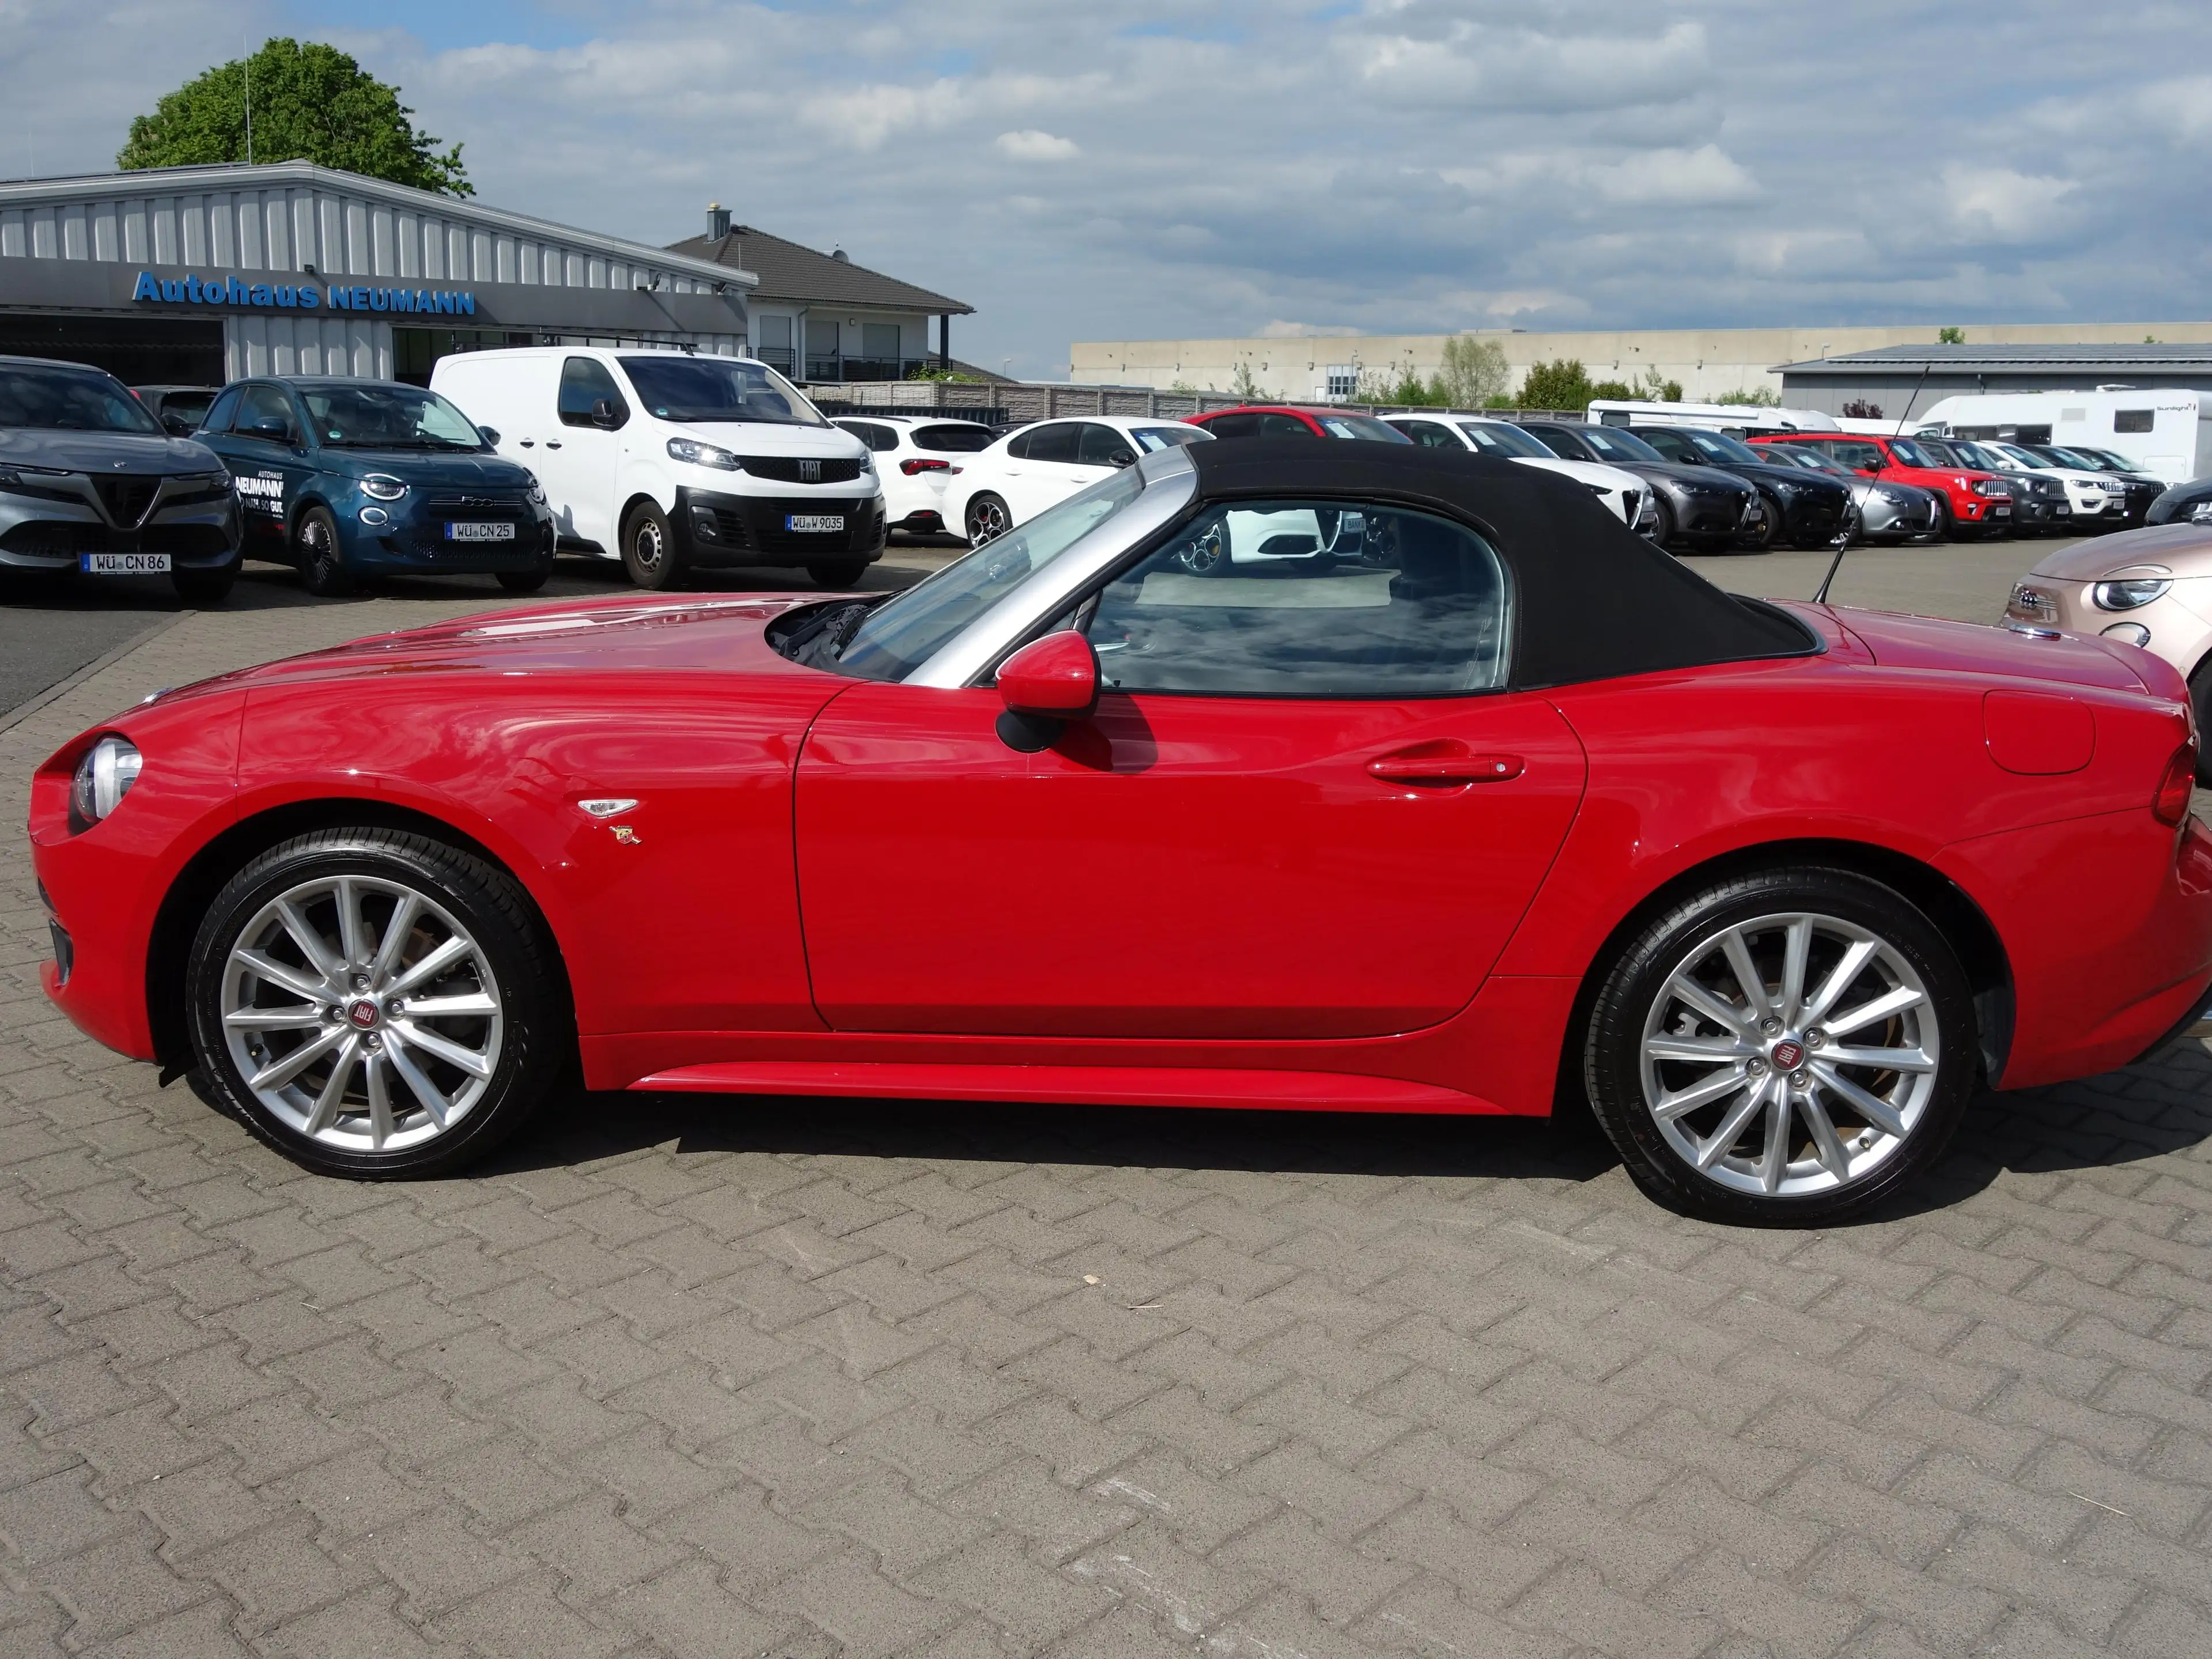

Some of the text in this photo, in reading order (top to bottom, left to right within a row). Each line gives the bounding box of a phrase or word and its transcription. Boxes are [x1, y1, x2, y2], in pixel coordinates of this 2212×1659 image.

[132, 271, 474, 315] Autohaus NEUMANN
[258, 471, 283, 479] AUTOHAUS
[800, 460, 821, 480] FIAT
[261, 499, 269, 511] SO
[462, 496, 493, 506] 500
[793, 517, 842, 528] WÜ W 9035
[457, 525, 509, 536] WÜ CN 25
[96, 556, 164, 569] WÜ CN 86
[354, 1005, 373, 1022] FIAT
[1778, 1045, 1797, 1065] FIAT
